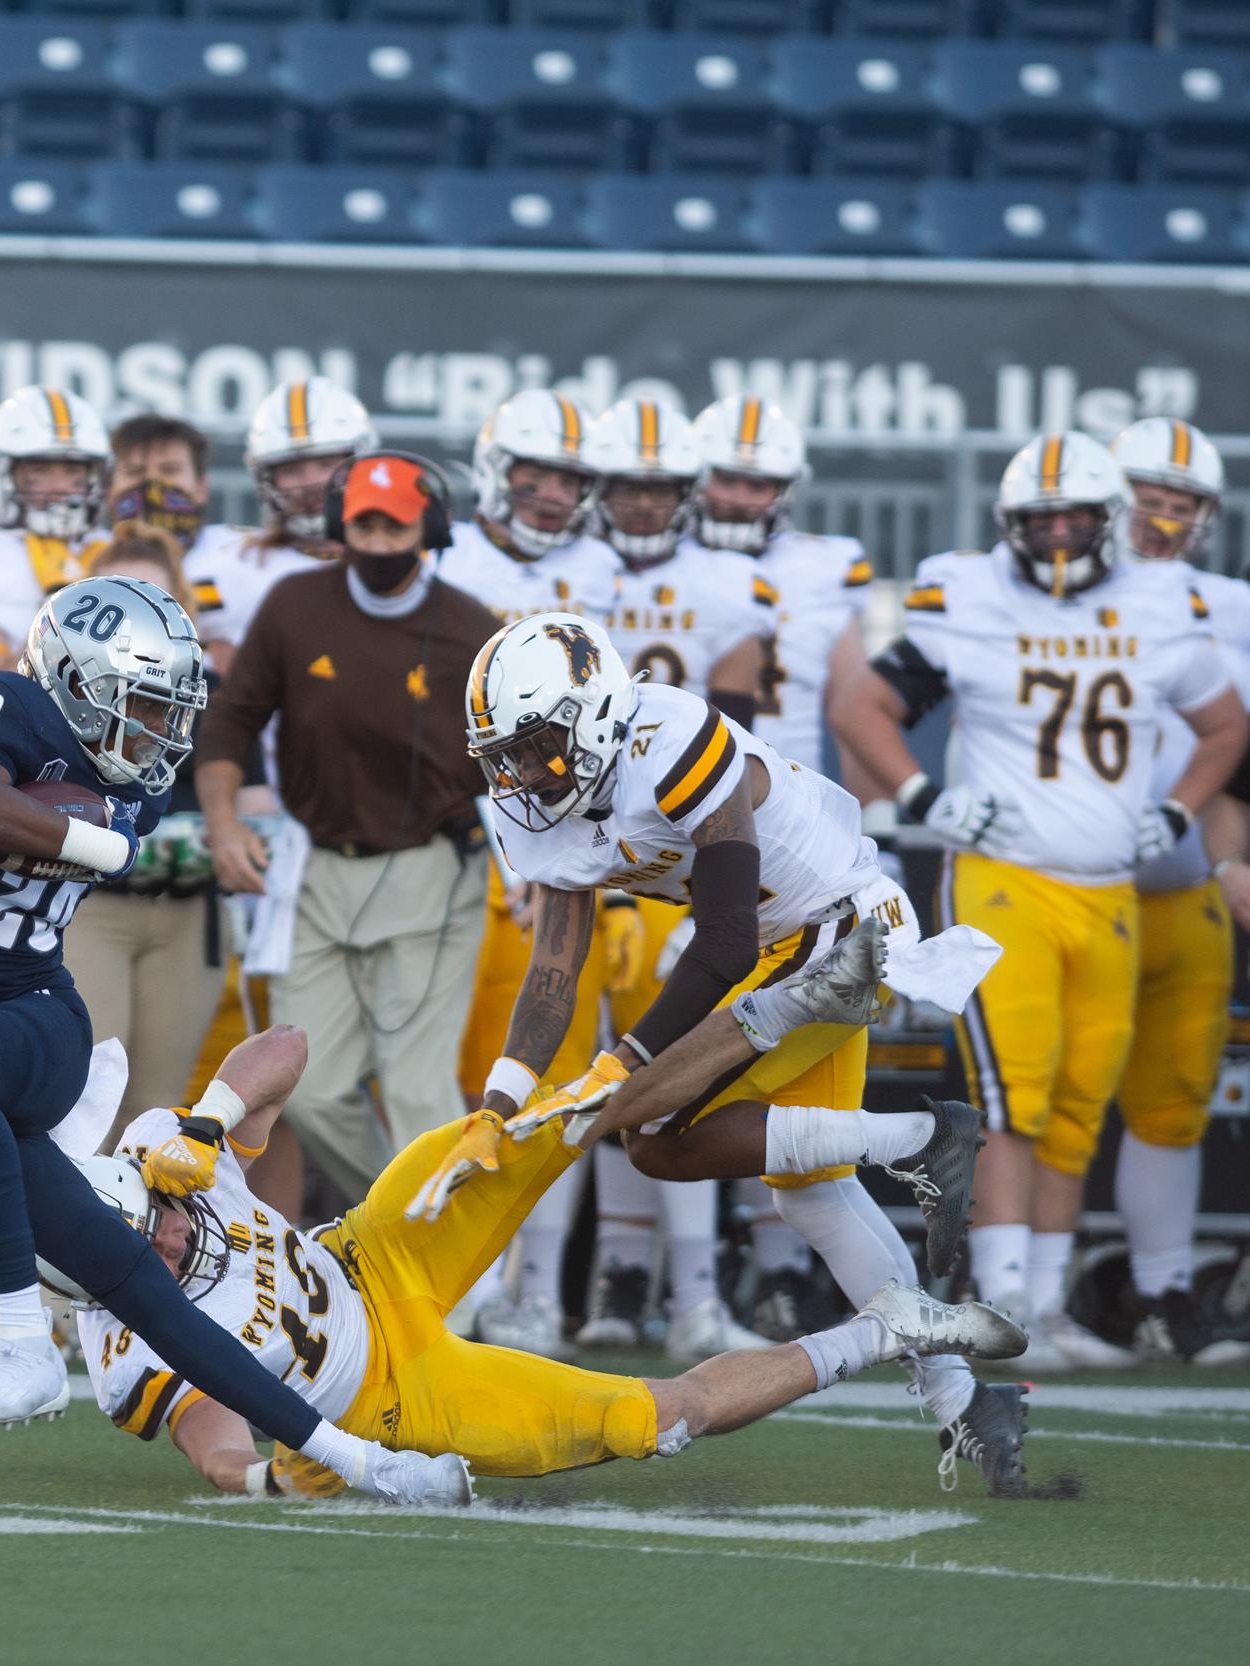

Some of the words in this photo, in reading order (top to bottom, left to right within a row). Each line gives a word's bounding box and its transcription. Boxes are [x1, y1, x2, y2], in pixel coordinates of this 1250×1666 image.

[60, 592, 126, 644] 20
[1016, 633, 1138, 660] WYOMING
[145, 666, 166, 678] GRIT
[630, 720, 666, 760] 21
[1018, 668, 1134, 784] 76
[174, 1134, 197, 1165] adidas
[239, 1208, 277, 1349] WYOMING
